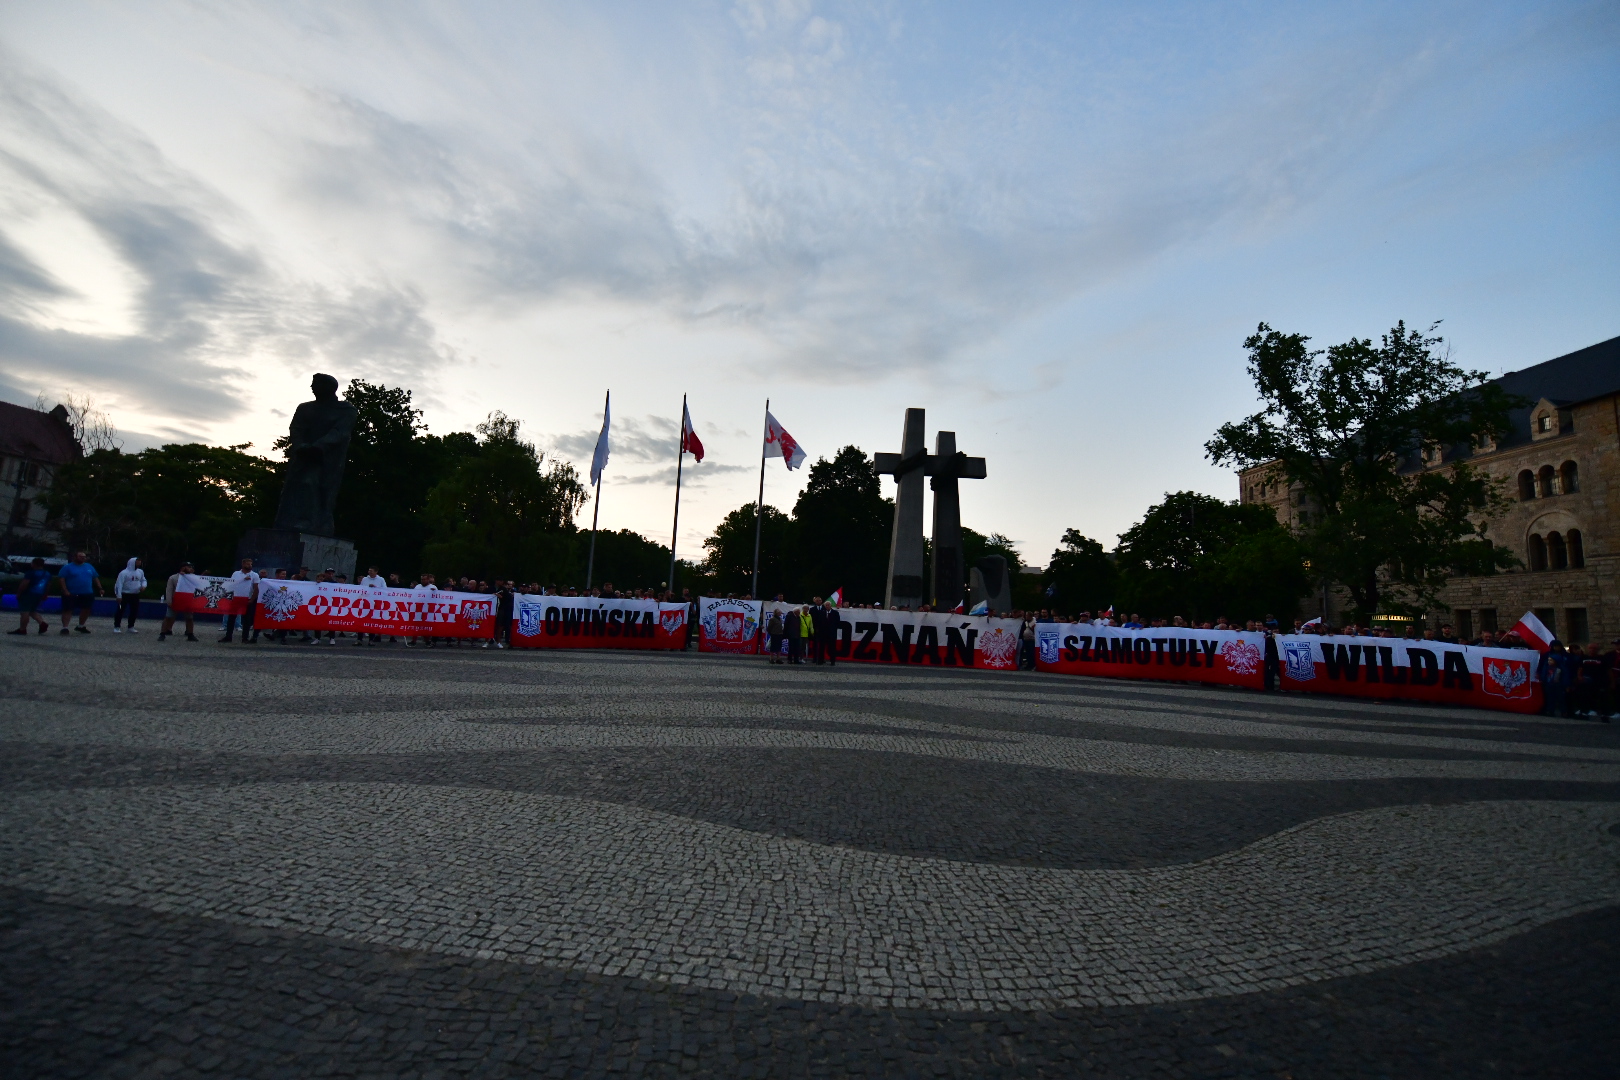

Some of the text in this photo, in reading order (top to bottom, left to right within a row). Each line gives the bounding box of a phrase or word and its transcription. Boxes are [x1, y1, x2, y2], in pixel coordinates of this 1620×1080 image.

[307, 595, 459, 623] OBORNIKI
[545, 603, 655, 638] OWIŃSKA
[707, 598, 756, 613] RATAJSCY
[834, 620, 979, 666] OZNAŃ
[1063, 635, 1218, 668] SZAMOTUŁY
[1319, 642, 1474, 690] WILDA
